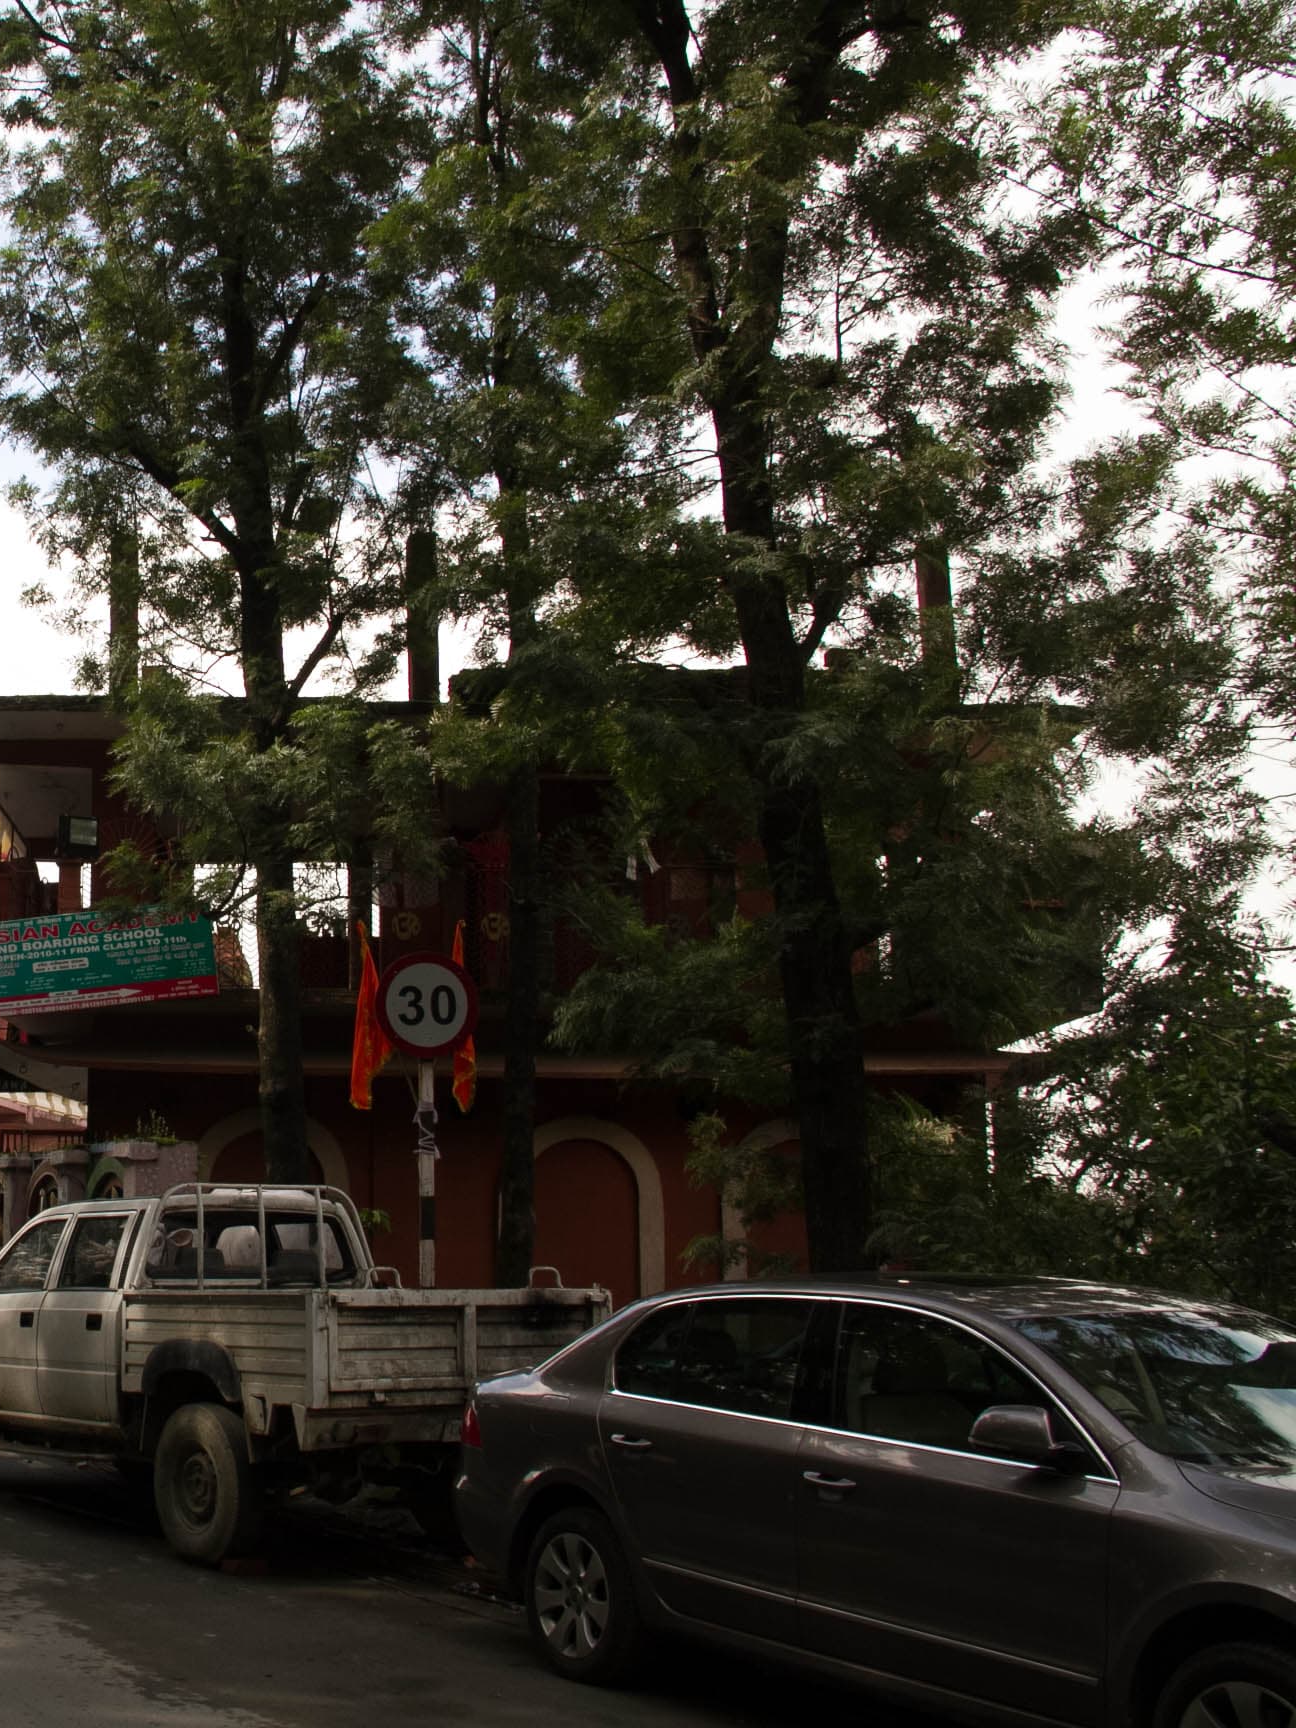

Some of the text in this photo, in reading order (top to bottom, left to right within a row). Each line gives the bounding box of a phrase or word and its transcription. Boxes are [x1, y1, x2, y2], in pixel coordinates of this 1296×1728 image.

[22, 935, 99, 952] BOARDING
[103, 928, 164, 943] SCHOOL
[70, 945, 100, 955] FROM
[104, 941, 137, 951] CLASS
[148, 938, 161, 947] TO
[164, 936, 187, 945] 11th
[398, 985, 456, 1026] 30
